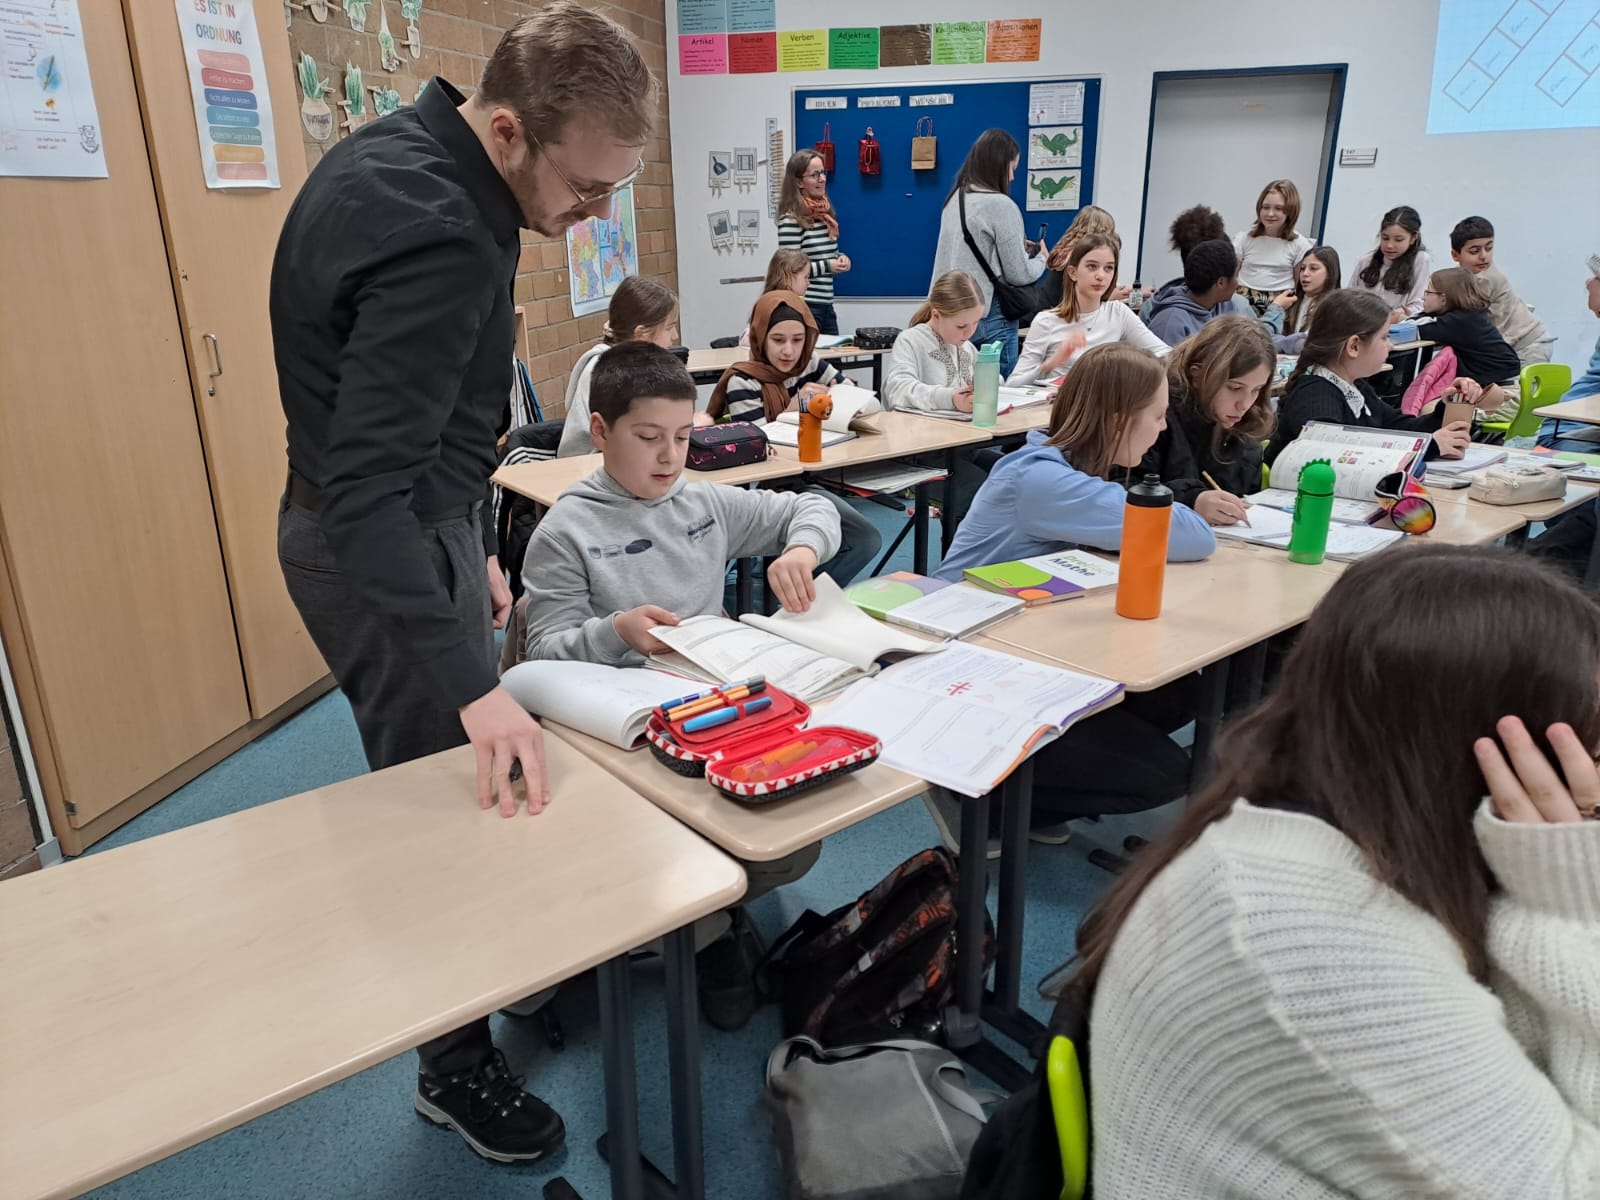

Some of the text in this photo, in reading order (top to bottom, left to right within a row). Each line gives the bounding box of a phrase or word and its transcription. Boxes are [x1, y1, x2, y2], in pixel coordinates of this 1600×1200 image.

[194, 0, 236, 18] ES IST IN
[195, 23, 242, 45] ORDNUNG
[790, 34, 814, 42] Verben
[838, 31, 871, 41] Adjektive
[691, 38, 714, 46] Artikel
[1048, 558, 1096, 577] Mathe
